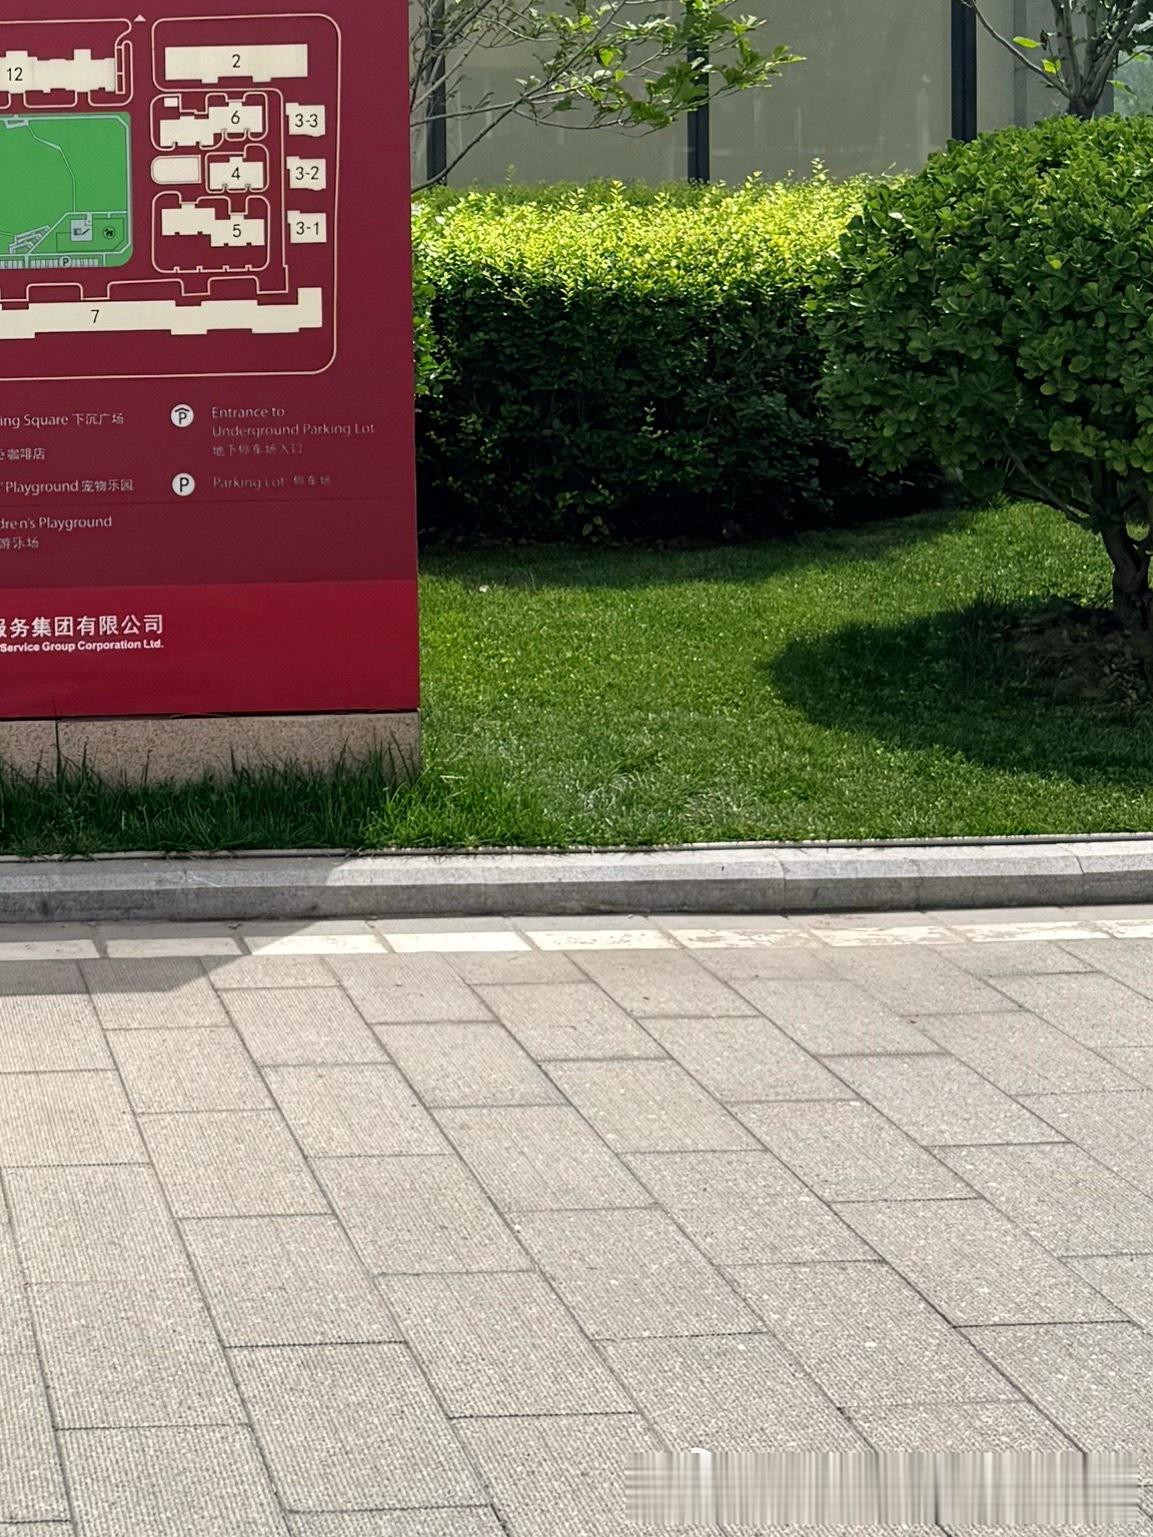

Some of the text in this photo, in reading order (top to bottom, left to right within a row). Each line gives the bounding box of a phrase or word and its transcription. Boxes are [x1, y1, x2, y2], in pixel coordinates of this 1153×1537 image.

[231, 54, 242, 69] 2
[6, 66, 24, 82] 12
[230, 109, 241, 125] 6
[294, 113, 319, 128] 3-3
[230, 166, 241, 181] 4
[294, 166, 320, 181] 3-2
[232, 223, 242, 238] 5
[295, 221, 320, 236] 3-1
[90, 309, 100, 324] 7
[211, 406, 286, 419] Entrance to
[23, 413, 69, 430] Square
[212, 422, 376, 438] Underground Parking Lot
[5, 480, 79, 496] Playground
[213, 475, 261, 490] Parking
[38, 516, 113, 532] Playground
[0, 642, 40, 654] Service
[42, 641, 76, 653] Group
[77, 639, 141, 652] Corporation
[143, 638, 165, 650] Ltd.
